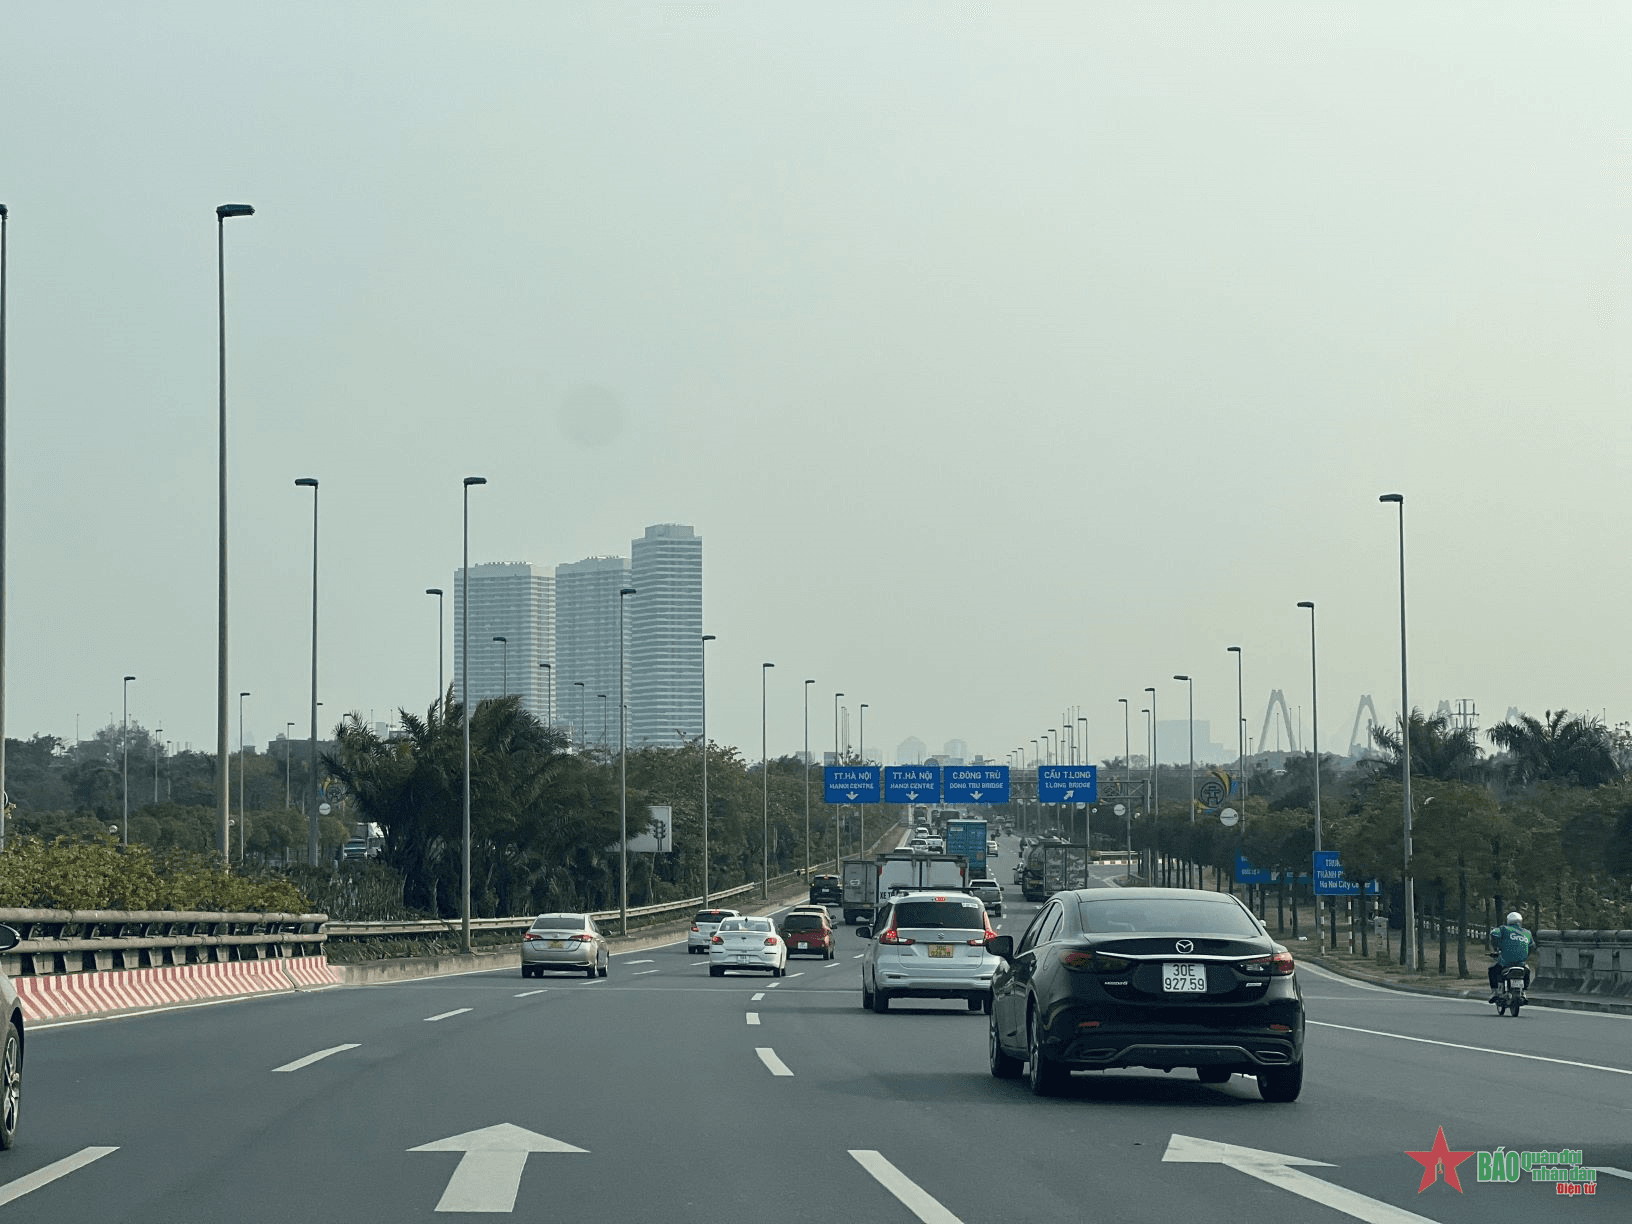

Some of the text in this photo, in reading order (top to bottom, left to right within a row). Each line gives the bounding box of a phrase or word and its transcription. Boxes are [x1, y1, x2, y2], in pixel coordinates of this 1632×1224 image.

[858, 771, 872, 781] NỘI
[919, 771, 933, 781] NỘI
[1339, 881, 1351, 890] City
[1510, 933, 1529, 944] Grab
[1172, 963, 1196, 977] 30E
[1164, 977, 1205, 991] 927.59
